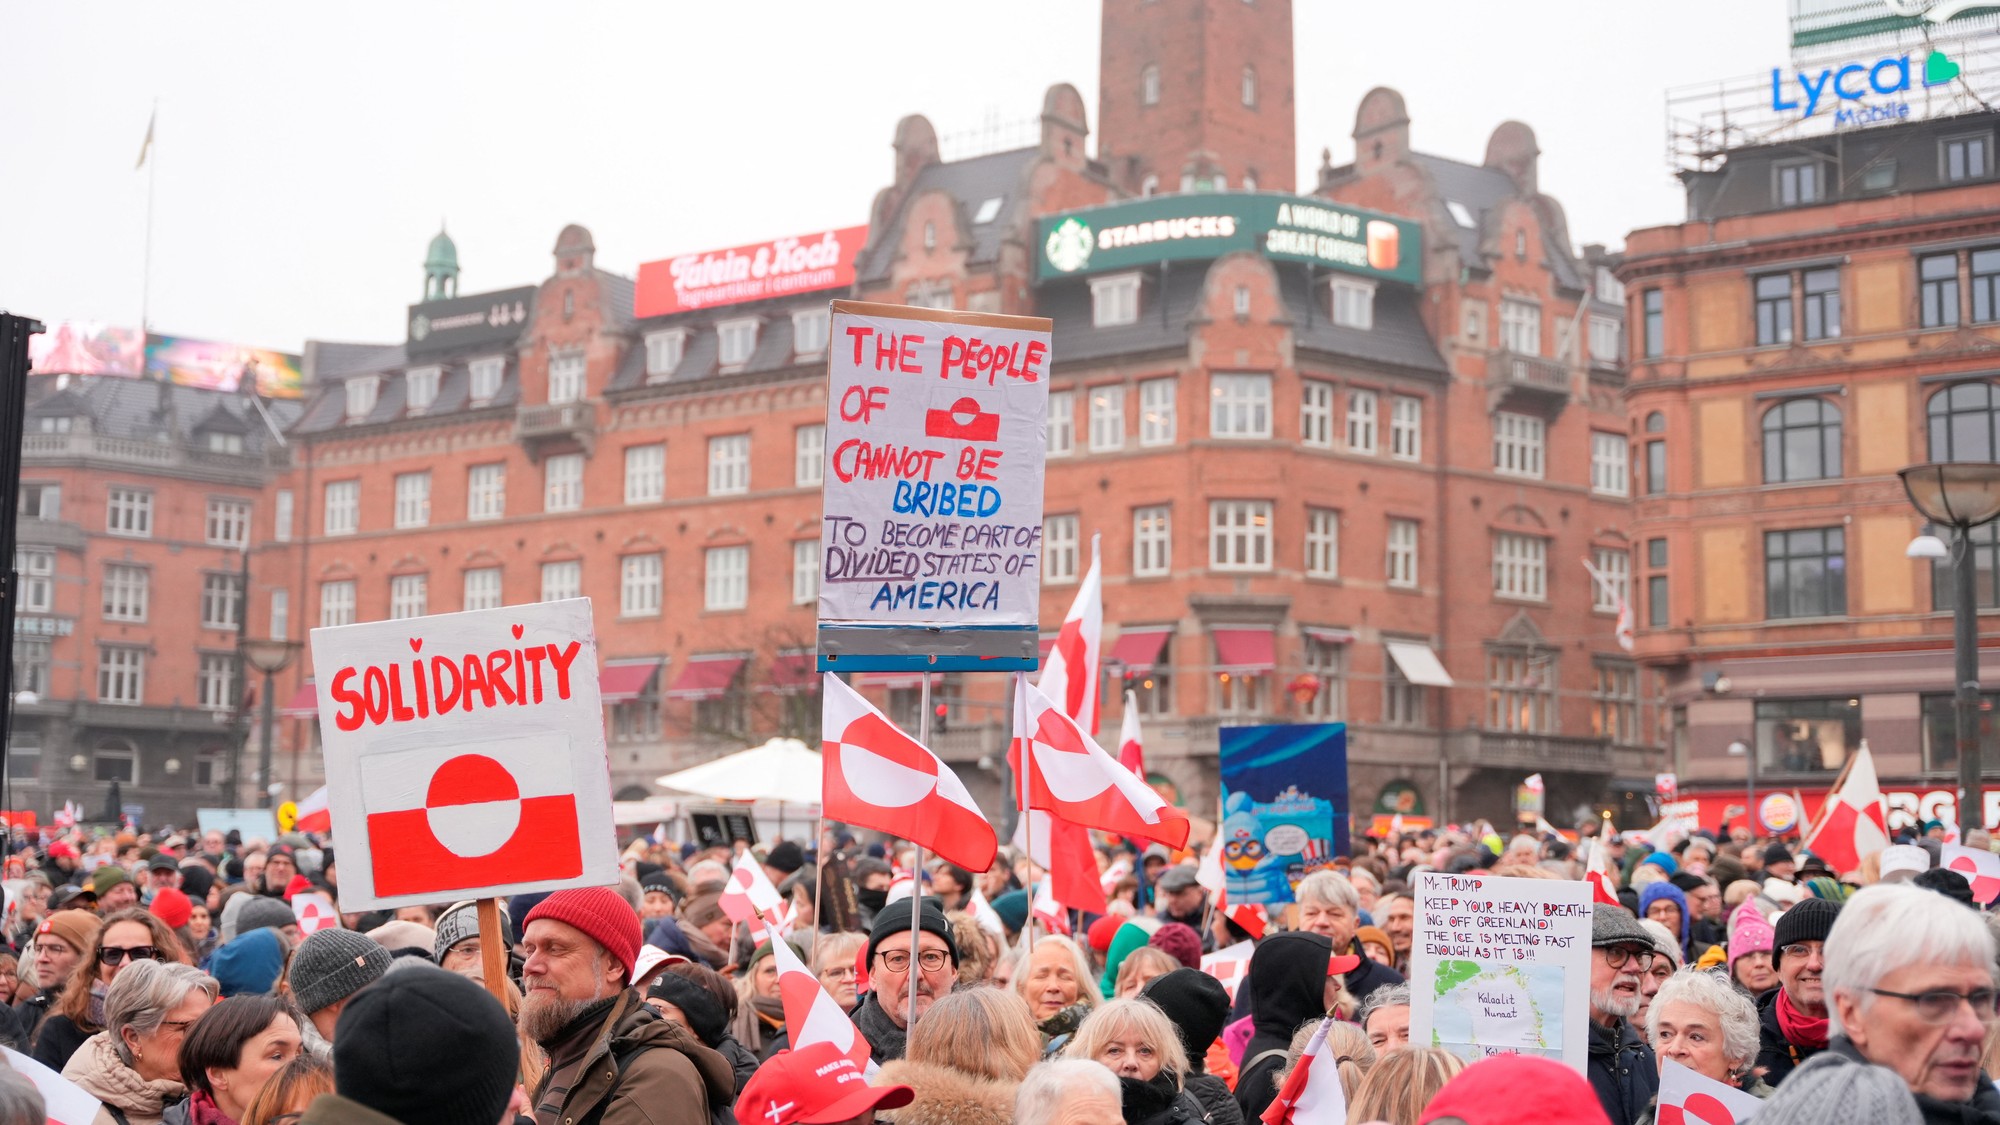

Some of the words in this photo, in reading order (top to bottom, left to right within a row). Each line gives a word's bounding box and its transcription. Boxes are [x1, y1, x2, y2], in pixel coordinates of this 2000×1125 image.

[1771, 53, 1910, 119] Lyca
[1834, 102, 1910, 128] Mobile
[1277, 202, 1292, 226] A
[1291, 204, 1343, 234] WORLD
[1098, 215, 1236, 250] STARBUCKS
[751, 246, 770, 278] &
[770, 230, 841, 274] Koch
[846, 326, 925, 374] THE
[939, 335, 1048, 386] PEOPLE
[840, 385, 890, 425] OF
[832, 438, 946, 483] CANNOT
[956, 445, 1004, 481] BE
[893, 480, 1002, 518] BRIBED
[824, 515, 867, 547] TO
[881, 520, 961, 548] BECOME
[962, 524, 1015, 549] PART
[1013, 525, 1042, 549] OF
[922, 552, 1002, 577] STATES
[1004, 553, 1036, 577] OF
[870, 580, 1000, 611] AMERICA
[1424, 876, 1442, 891] Mr.
[1442, 876, 1482, 892] TRUMP
[1424, 897, 1459, 911] KEEP
[1463, 899, 1494, 914] YOUR
[1499, 901, 1538, 915] HEAVY
[1543, 903, 1591, 918] BREATH-
[1449, 916, 1471, 928] OFF
[1477, 916, 1553, 930] GREENLAND!
[1424, 930, 1449, 942] THE
[1545, 935, 1575, 948] FAST
[1426, 943, 1470, 957] ENOUGH
[1474, 946, 1490, 959] AS
[1478, 992, 1515, 1005] Kalaalit
[1484, 1007, 1518, 1018] Nunaat
[816, 1061, 840, 1077] MAKE
[837, 1073, 850, 1084] GO
